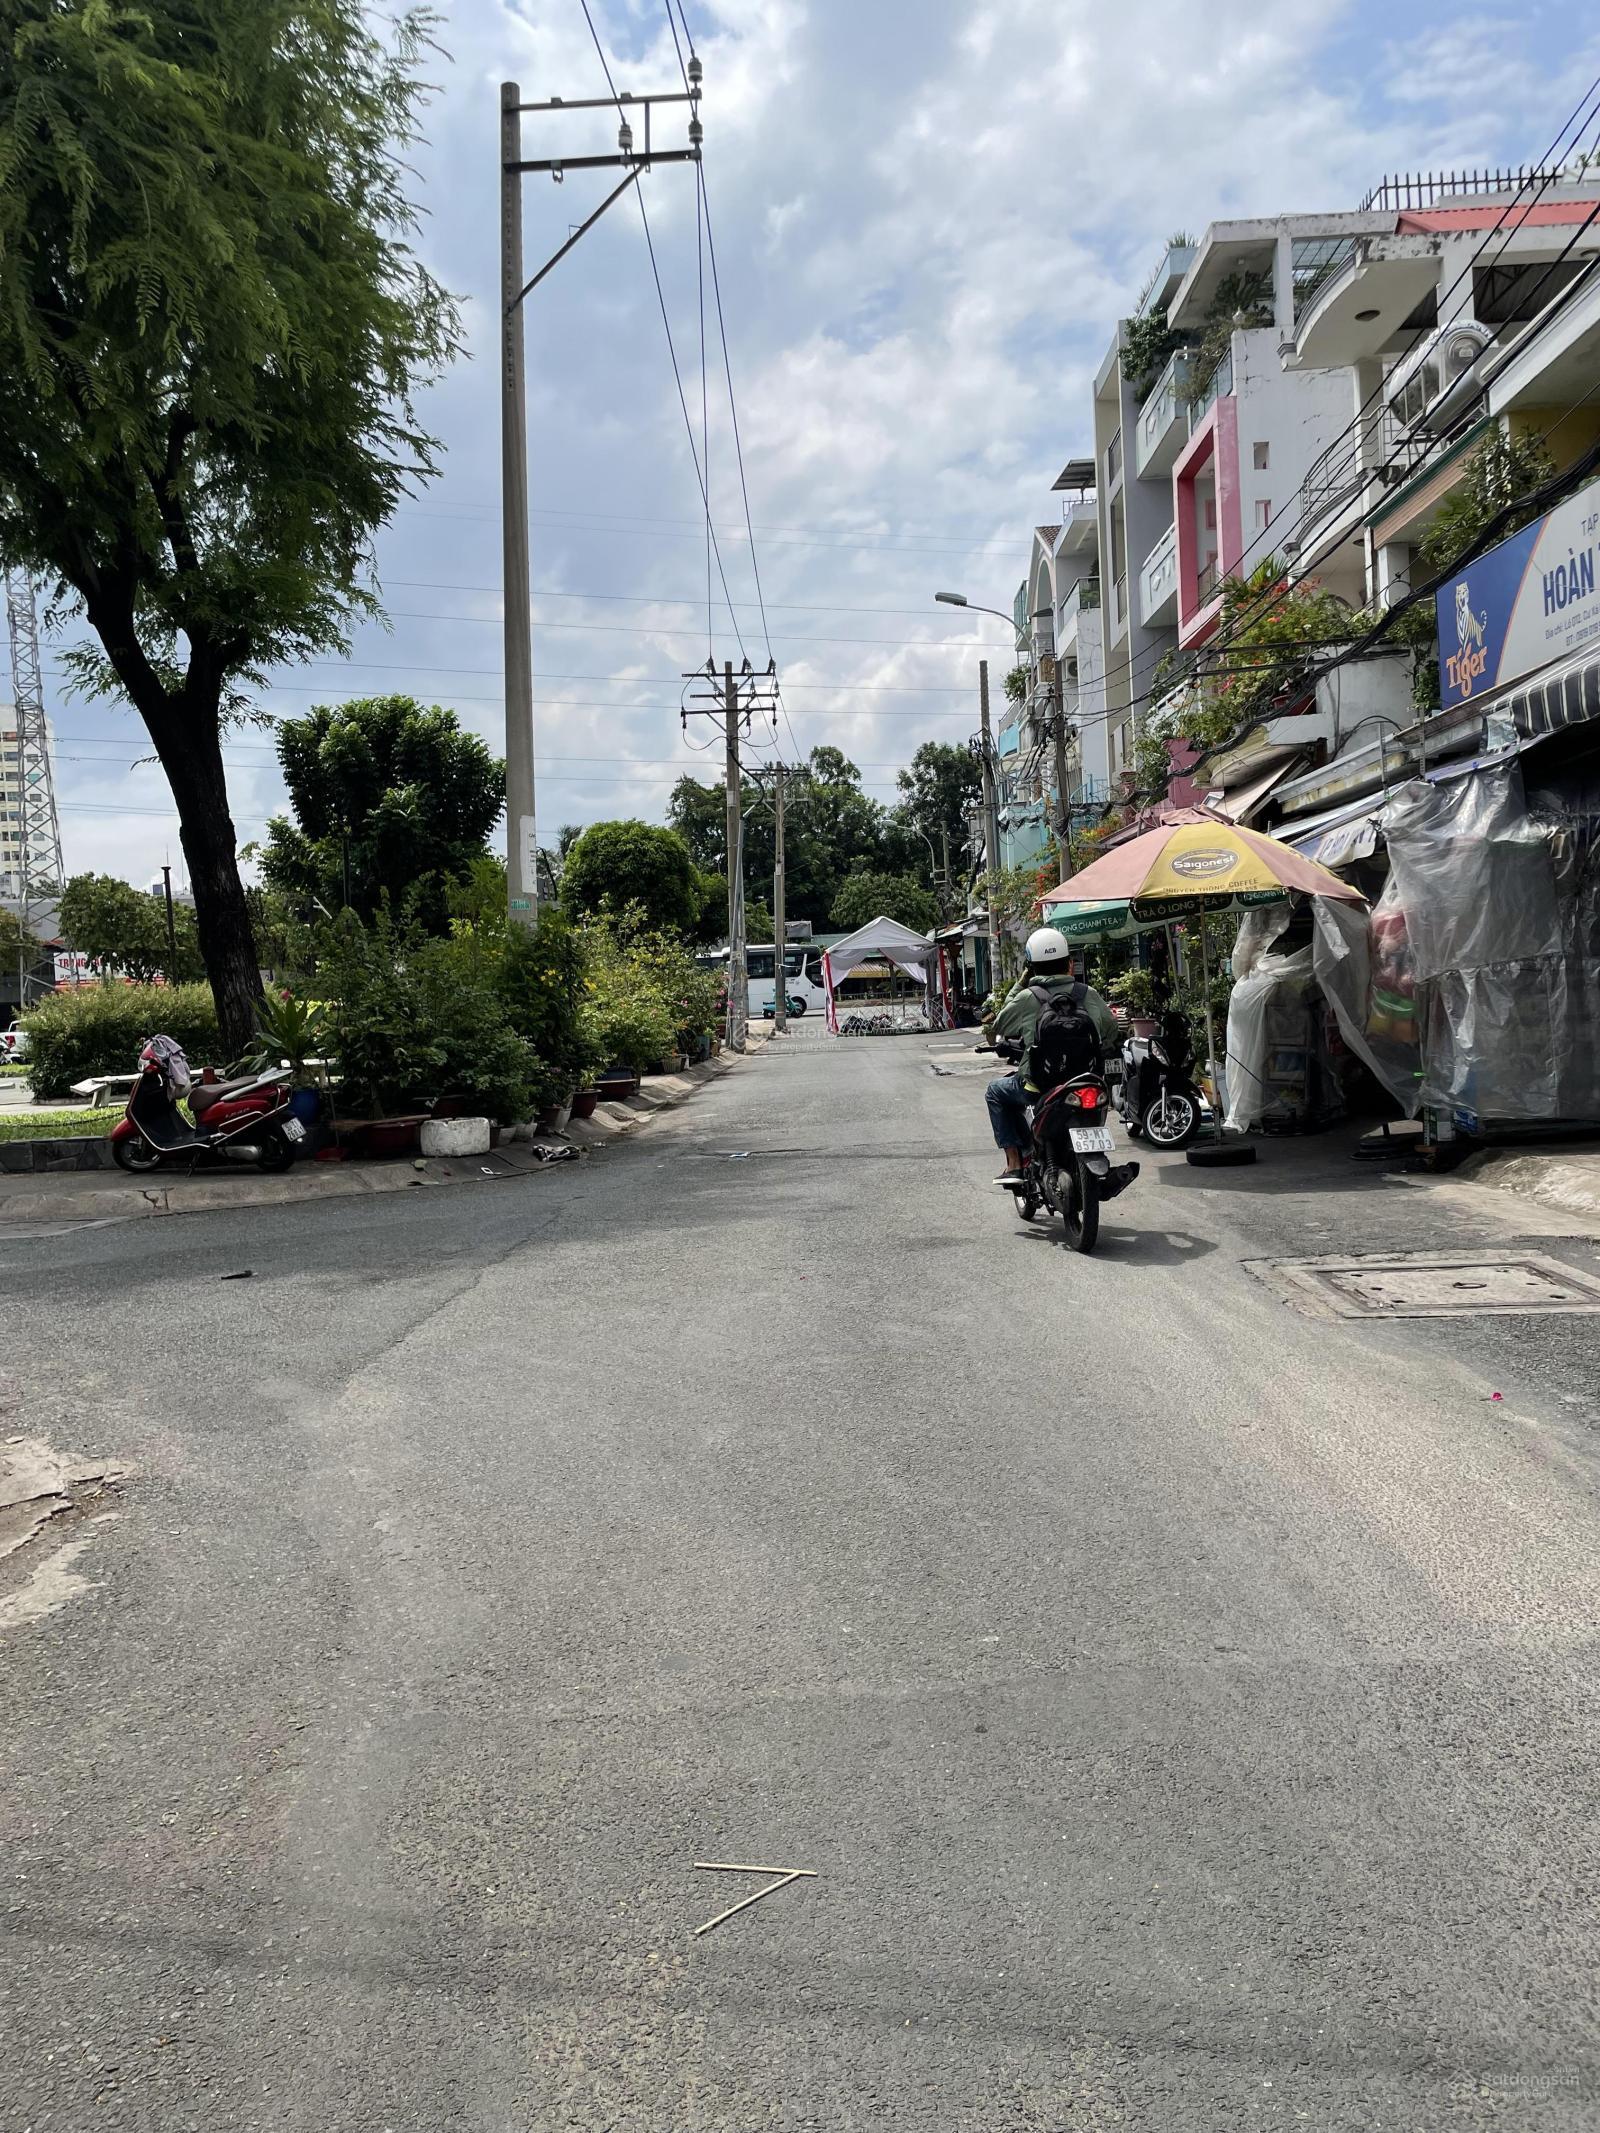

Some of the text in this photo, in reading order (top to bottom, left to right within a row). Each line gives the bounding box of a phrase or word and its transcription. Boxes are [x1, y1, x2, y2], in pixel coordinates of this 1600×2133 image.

[1543, 548, 1594, 616] HOÀN
[1446, 642, 1487, 697] Tiger
[1173, 854, 1234, 870] Saigonest
[1228, 878, 1259, 888] COFFEE
[1168, 900, 1195, 912] LONG
